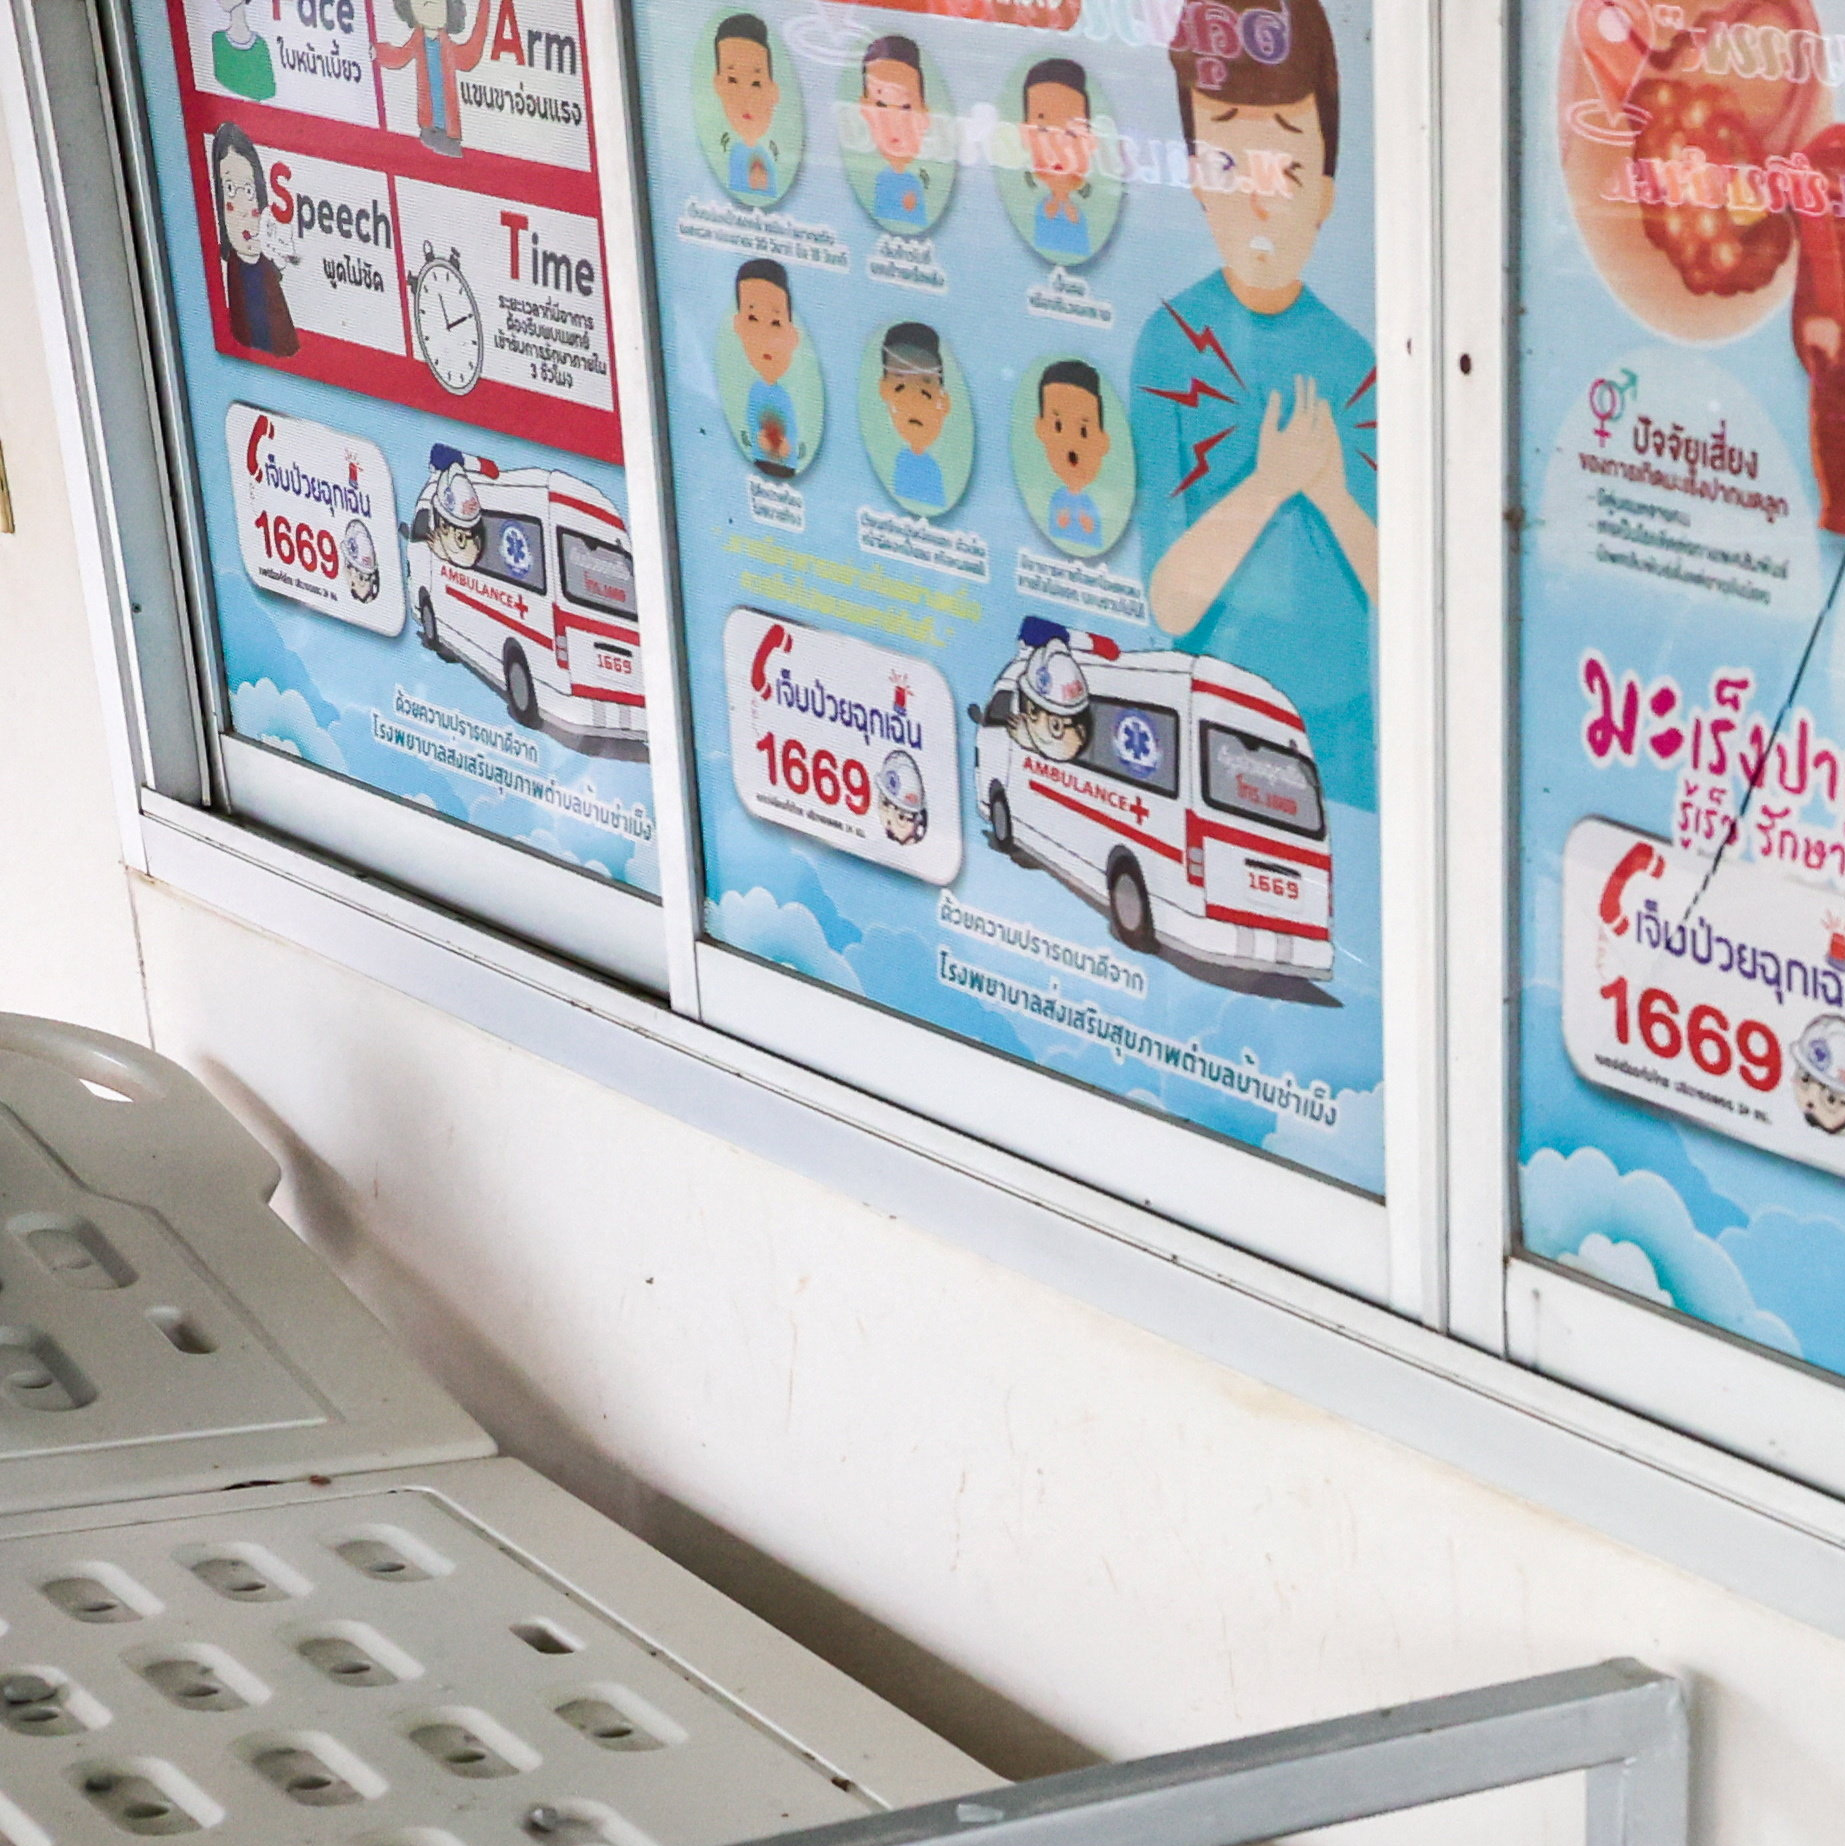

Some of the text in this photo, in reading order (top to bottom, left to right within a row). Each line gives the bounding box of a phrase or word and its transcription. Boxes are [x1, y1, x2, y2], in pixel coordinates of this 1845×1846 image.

[272, 0, 355, 34] ace
[490, 0, 578, 76] Arm
[277, 36, 362, 83] ใบหน้าเบี้ยว
[460, 81, 582, 126] แขนขาอ่อนแรง
[269, 160, 392, 250] Speech
[500, 210, 596, 297] Time
[1632, 414, 1759, 481] ปัจจัยเสี่ยง
[265, 454, 372, 519] เจ็บป่วยฉุกเฉิน
[254, 509, 340, 580] 1669
[440, 564, 515, 609] AMBULANCE
[596, 653, 633, 675] 1669
[775, 668, 923, 750] เจ็บป่วยฉุกเฉิน
[756, 731, 872, 816] 1669
[1022, 755, 1130, 813] AMBULANCE
[1248, 871, 1301, 901] 1669
[1600, 975, 1784, 1093] 1669
